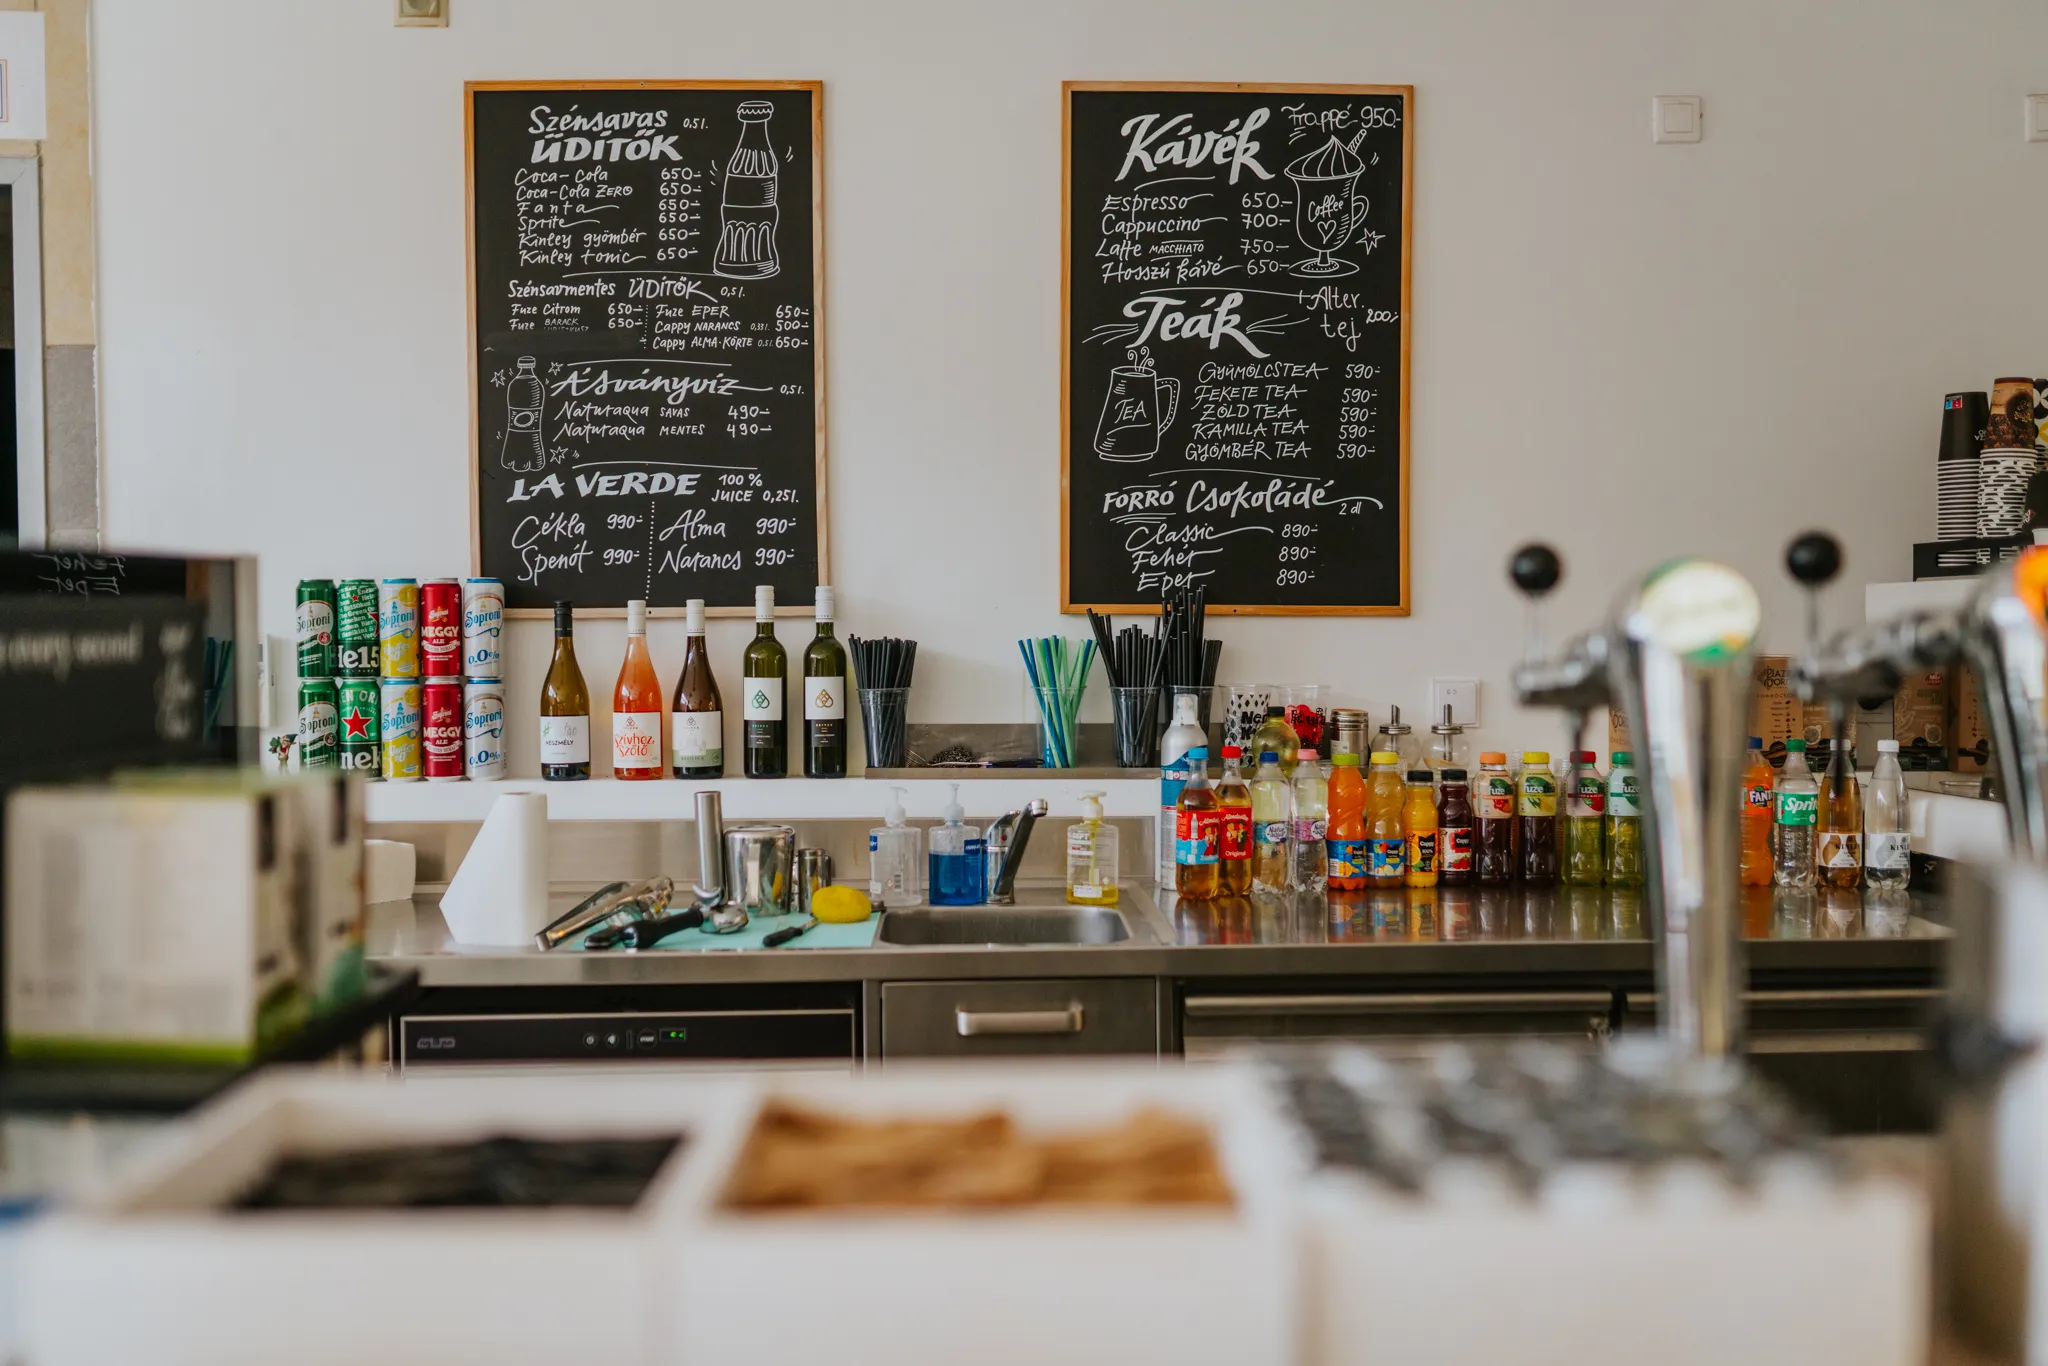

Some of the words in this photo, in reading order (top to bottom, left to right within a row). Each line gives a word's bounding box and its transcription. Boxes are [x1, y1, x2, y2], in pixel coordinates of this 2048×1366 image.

[528, 105, 668, 135] Szénsavas
[1115, 107, 1275, 187] Kávék
[1281, 103, 1358, 134] Frappé
[516, 184, 589, 201] Coca-Cola
[595, 185, 633, 198] ZERO
[517, 201, 619, 218] Fanta
[1102, 194, 1213, 216] Espresso
[1307, 195, 1344, 223] Coffee
[518, 215, 600, 237] Sprite
[1102, 212, 1228, 241] Cappuccino
[518, 231, 571, 249] Kinley
[584, 228, 646, 247] gyömbér
[519, 249, 572, 266] Kinley
[581, 249, 646, 265] tonic
[1095, 238, 1141, 261] Latte
[1149, 244, 1204, 254] MACCHIATO
[1102, 262, 1170, 283] Hosszú
[1175, 255, 1241, 284] kávé
[508, 278, 616, 297] Szénsavmentes
[511, 304, 537, 315] Fuze
[543, 303, 580, 315] Citrom
[656, 304, 683, 318] Fuze
[692, 305, 730, 319] EPER
[509, 319, 534, 330] Fuze
[545, 318, 578, 328] BARACK
[655, 321, 691, 334] Cappy
[694, 321, 741, 331] NARANCS
[1122, 292, 1270, 358] Teák
[1320, 314, 1361, 352] tej
[653, 337, 685, 352] Cappy
[550, 367, 774, 405] Ásványvíz
[1191, 385, 1260, 412] FEKETE
[1265, 384, 1307, 400] TEA
[554, 401, 649, 424] Naturaqua
[660, 407, 689, 418] SAVAS
[1115, 398, 1146, 423] TEA
[1200, 404, 1249, 421] ZÖLD
[1253, 404, 1297, 419] TEA
[553, 422, 645, 443] Naturaqua
[659, 424, 705, 436] MENTES
[1192, 423, 1267, 441] KAMILLA
[1272, 419, 1309, 436] TEA
[1276, 441, 1311, 458] TEA
[506, 473, 565, 503] LA
[575, 471, 701, 497] VERDE
[711, 489, 753, 502] JUICE
[1103, 481, 1177, 513] FORRÓ
[1186, 479, 1383, 518] Csokoládé
[1339, 503, 1347, 515] 2
[1351, 502, 1361, 514] dl
[659, 509, 726, 541] Alma
[1124, 521, 1273, 551] Classic
[518, 540, 593, 586] Spenót
[658, 545, 741, 573] Narancs
[1132, 544, 1223, 573] Fehér
[1137, 570, 1215, 597] Eper
[297, 613, 330, 632] Soproni
[380, 608, 415, 629] Soproni
[465, 608, 500, 627] Soproni
[421, 626, 459, 637] MEGGY
[300, 714, 335, 734] Soproni
[382, 711, 419, 730] Soproni
[466, 709, 502, 728] Soproni
[423, 726, 461, 737] MEGGY
[1488, 786, 1505, 795] fuze
[1524, 785, 1544, 793] fuze
[1785, 797, 1818, 814] Sprit
